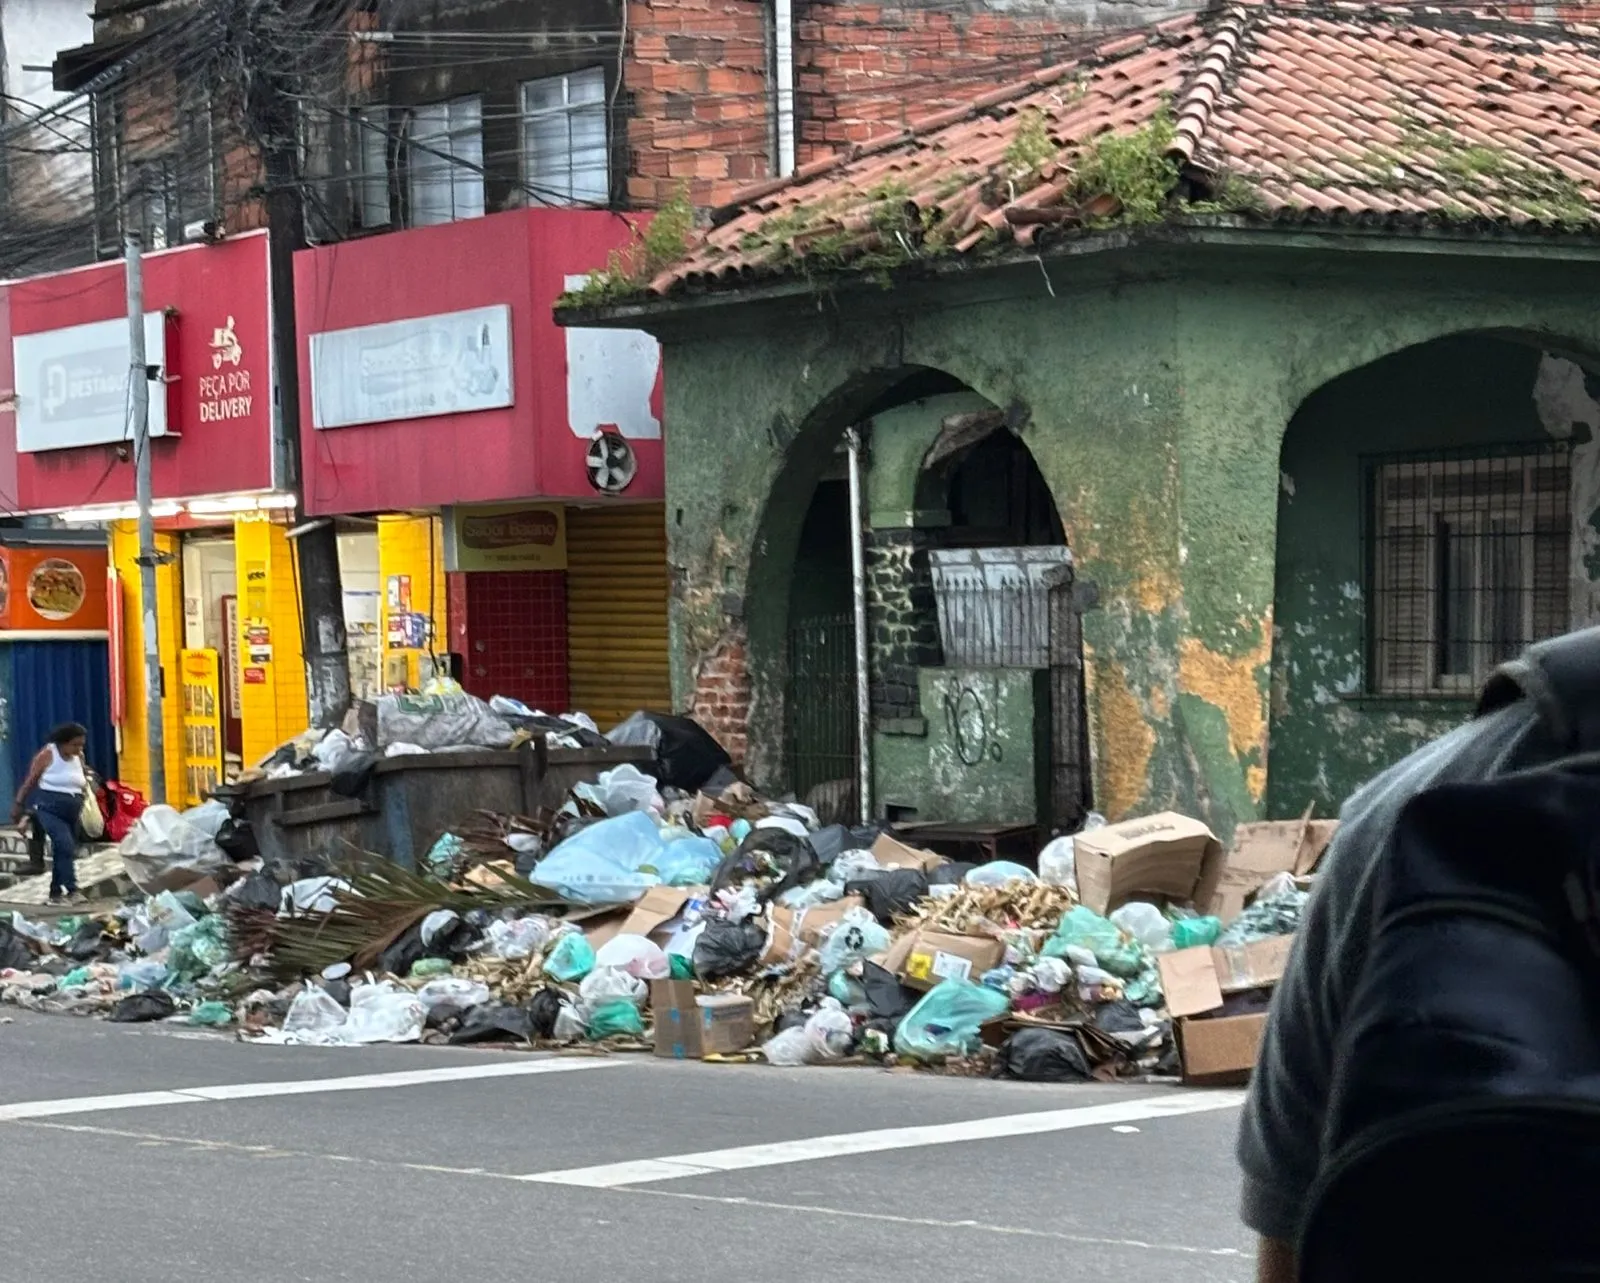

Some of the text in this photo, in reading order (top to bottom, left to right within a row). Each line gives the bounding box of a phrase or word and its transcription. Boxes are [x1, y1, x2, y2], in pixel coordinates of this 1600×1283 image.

[199, 369, 250, 400] PEÇA POR
[199, 395, 252, 423] DELIVERY
